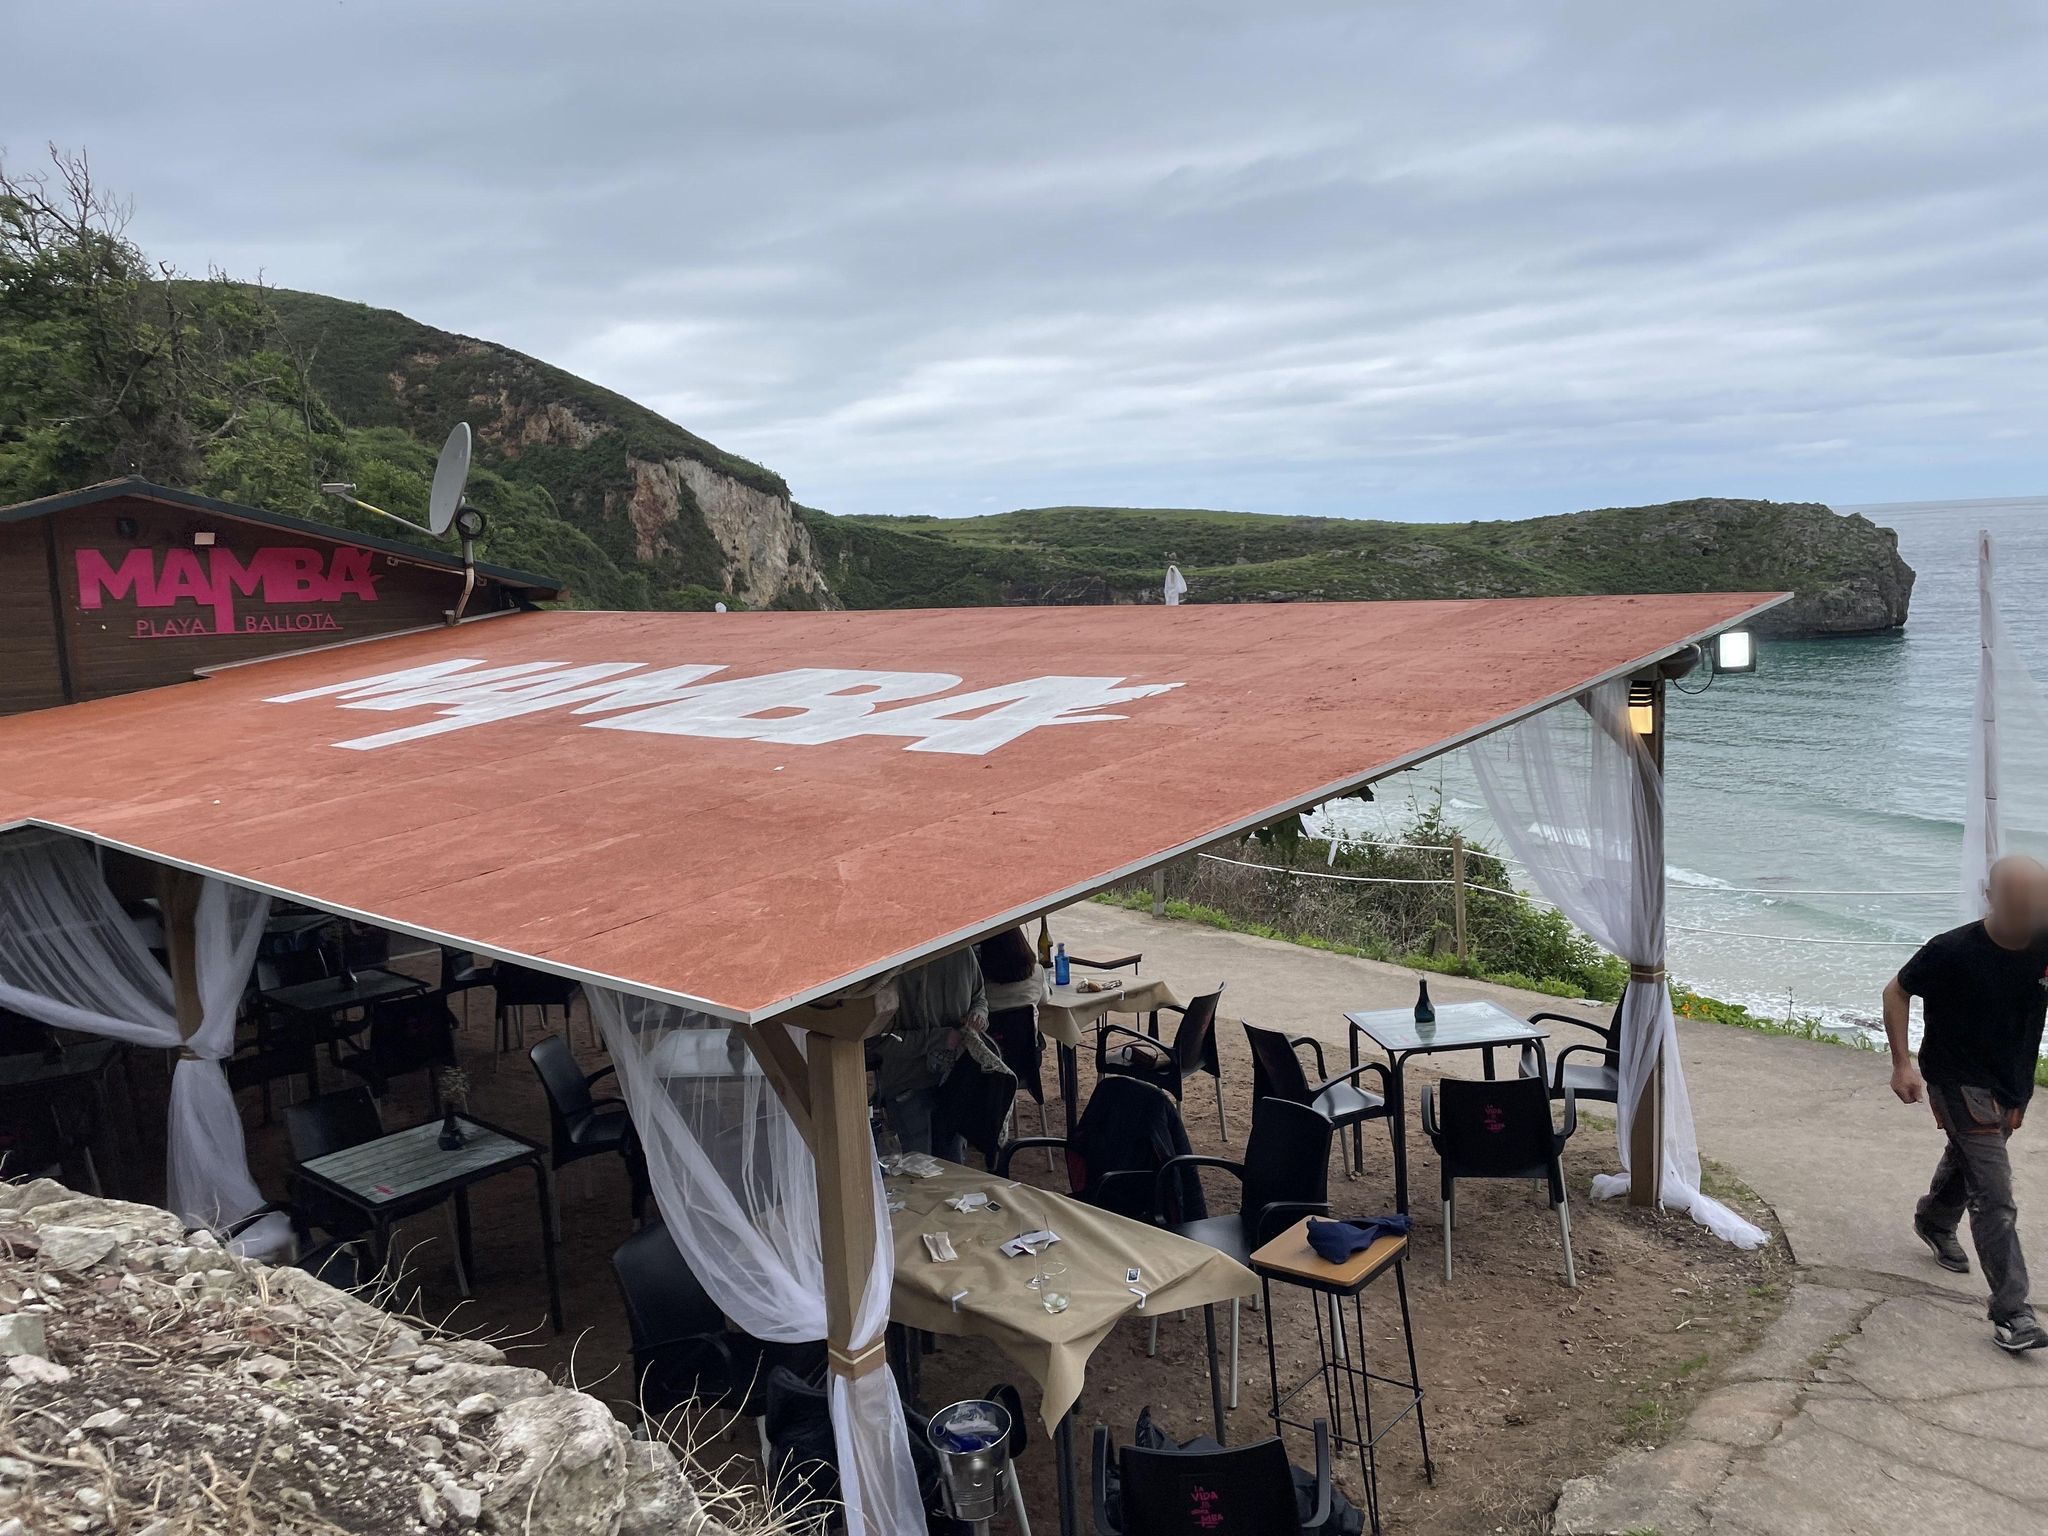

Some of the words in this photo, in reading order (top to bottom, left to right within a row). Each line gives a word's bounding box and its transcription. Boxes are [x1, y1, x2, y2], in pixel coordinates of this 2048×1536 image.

[75, 547, 381, 632] MAMBA
[136, 617, 206, 636] PLAYA
[245, 613, 337, 631] BALLOTA
[1190, 1491, 1219, 1501] VIDA
